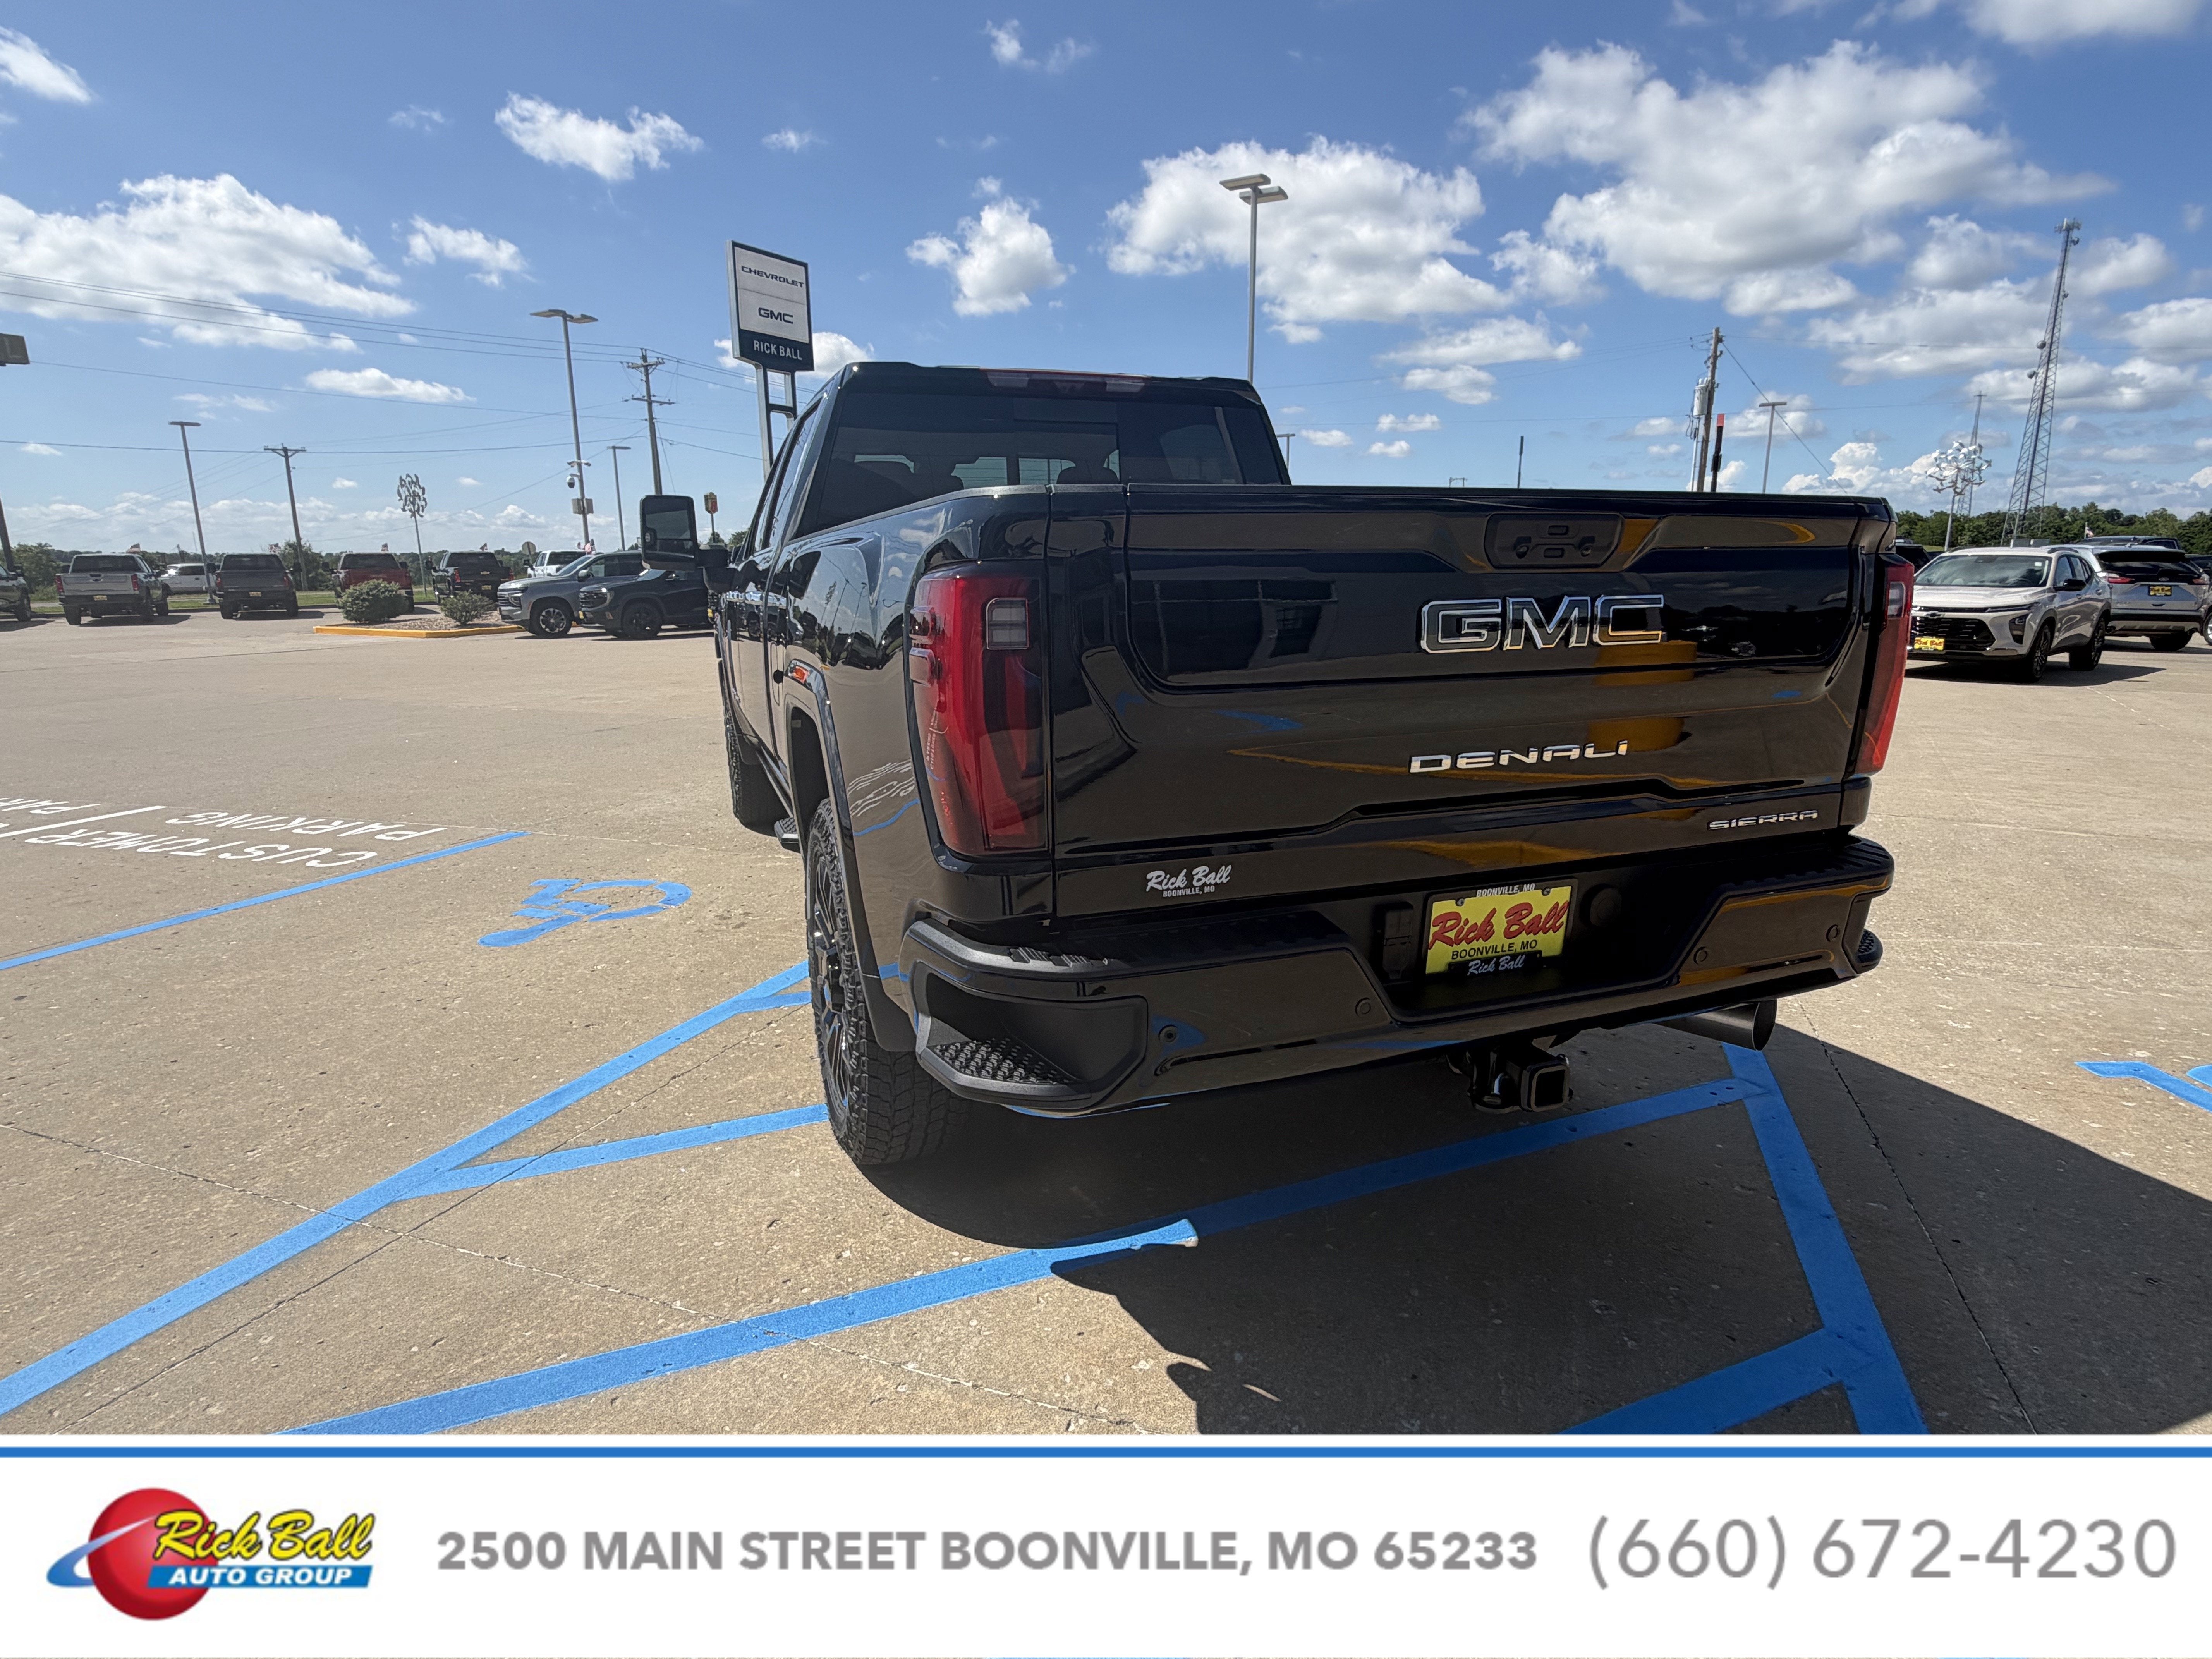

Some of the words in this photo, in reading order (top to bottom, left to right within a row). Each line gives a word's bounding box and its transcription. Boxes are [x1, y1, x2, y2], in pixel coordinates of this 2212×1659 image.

[741, 266, 804, 288] CHEVROLET
[758, 307, 793, 324] GMC
[753, 340, 777, 355] RICK
[779, 344, 802, 361] BALL
[1420, 595, 1664, 654] GMC
[1410, 740, 1628, 773] DENALI
[165, 812, 448, 841] PARKING
[1708, 810, 1818, 830] SIERRA
[25, 829, 377, 867] CUSTOMER
[1146, 869, 1187, 892] Rick
[1192, 864, 1231, 886] Ball
[1163, 886, 1202, 898] BOONVILLE,
[1476, 885, 1520, 897] BOONVILLE,
[1523, 883, 1535, 891] MO
[1428, 907, 1497, 950] Rick
[1503, 900, 1569, 939] Ball
[1451, 942, 1517, 960] BOONVILLE,
[1520, 939, 1538, 951] MO
[1467, 958, 1496, 976] Rick
[1499, 954, 1526, 971] Ball
